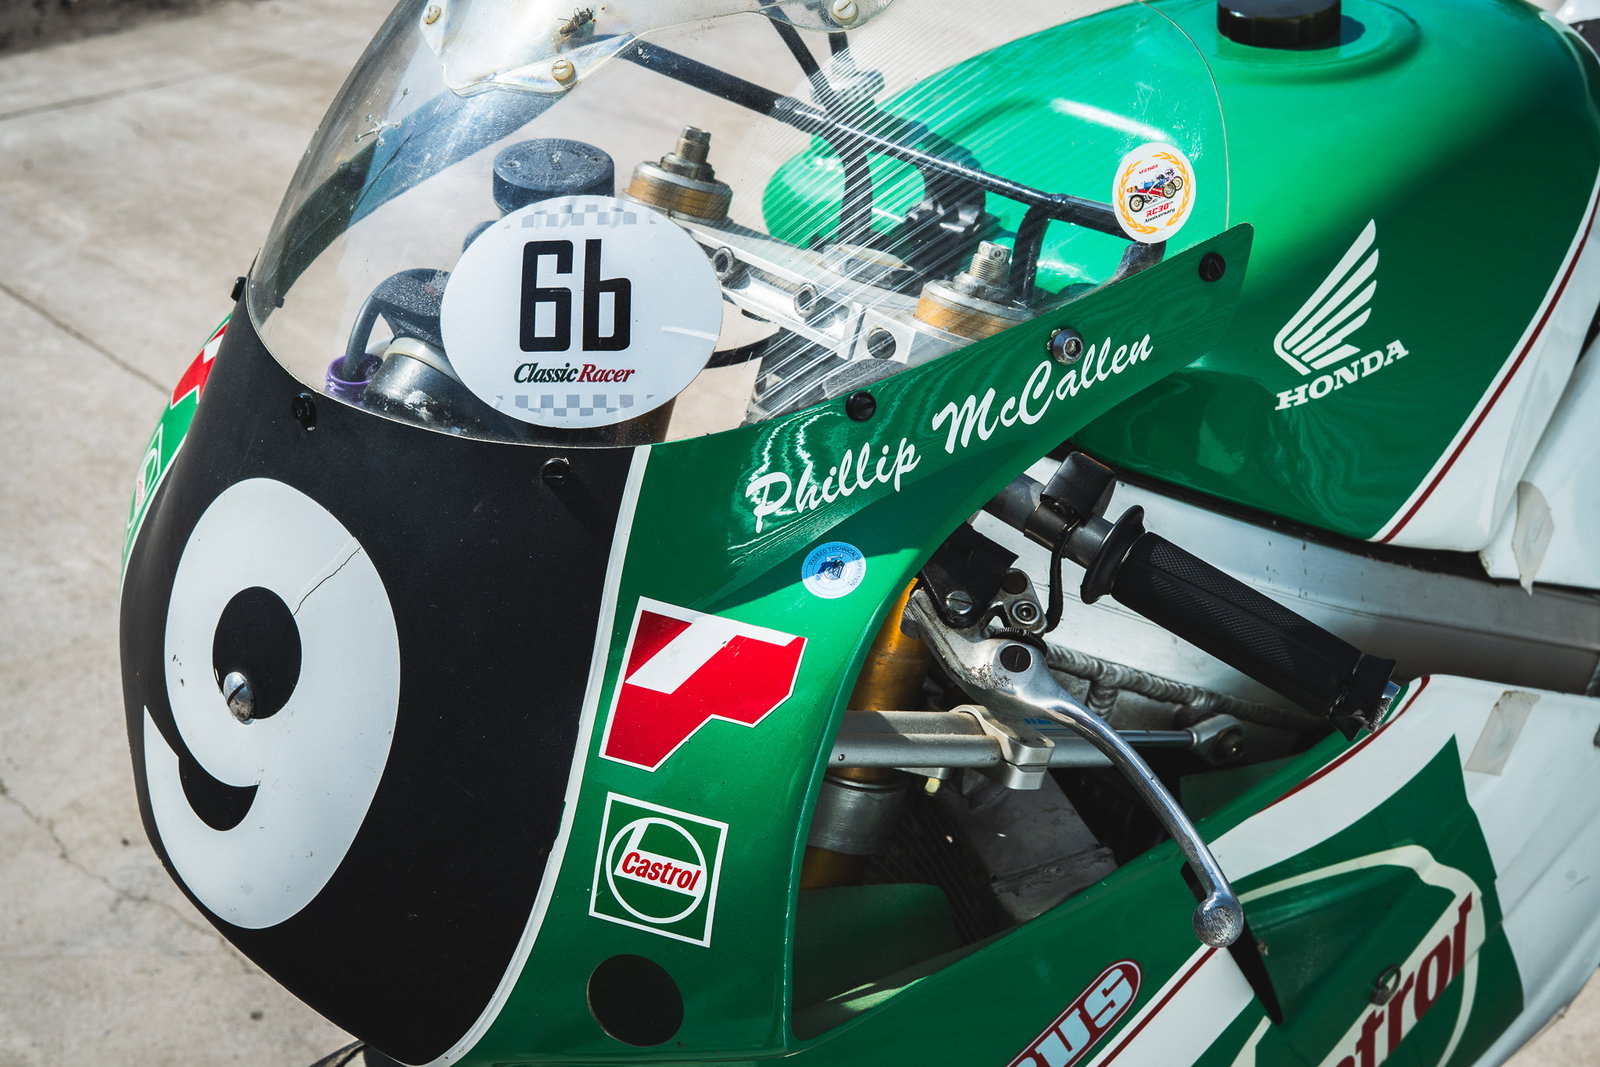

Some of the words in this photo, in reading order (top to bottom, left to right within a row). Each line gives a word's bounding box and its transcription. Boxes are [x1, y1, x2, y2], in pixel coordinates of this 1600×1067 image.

[1144, 207, 1176, 223] Anniversary
[519, 238, 632, 353] 6b
[1274, 338, 1409, 411] HONDA
[744, 436, 921, 533] Phillip
[931, 333, 1153, 454] McCallen
[143, 477, 401, 930] 9
[621, 851, 702, 891] Castrol
